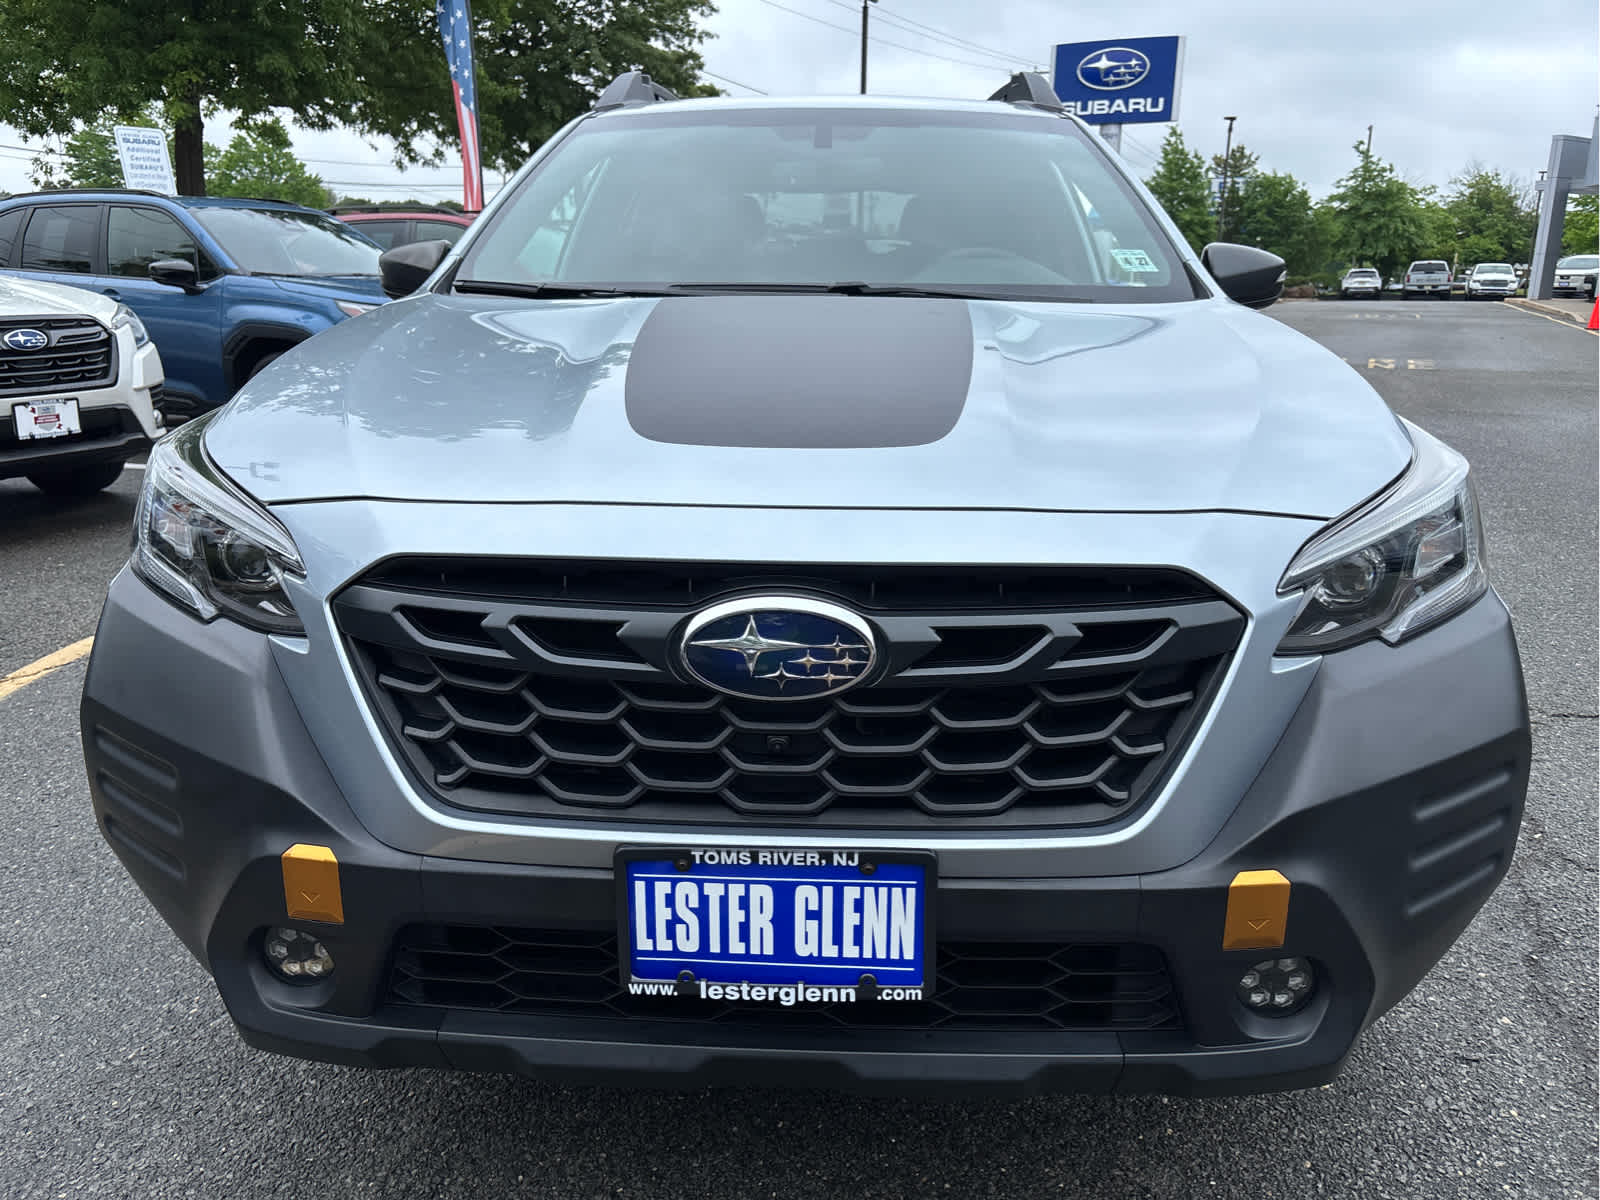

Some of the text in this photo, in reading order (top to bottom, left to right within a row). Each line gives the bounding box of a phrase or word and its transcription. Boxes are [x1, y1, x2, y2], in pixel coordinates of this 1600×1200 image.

[1062, 97, 1165, 116] SUBARU
[122, 137, 161, 145] SUBARU
[691, 851, 859, 867] TOMS RIVER, NJ
[634, 880, 916, 960] LESTER GLENN
[628, 980, 923, 1005] www. lesterglenn .com
